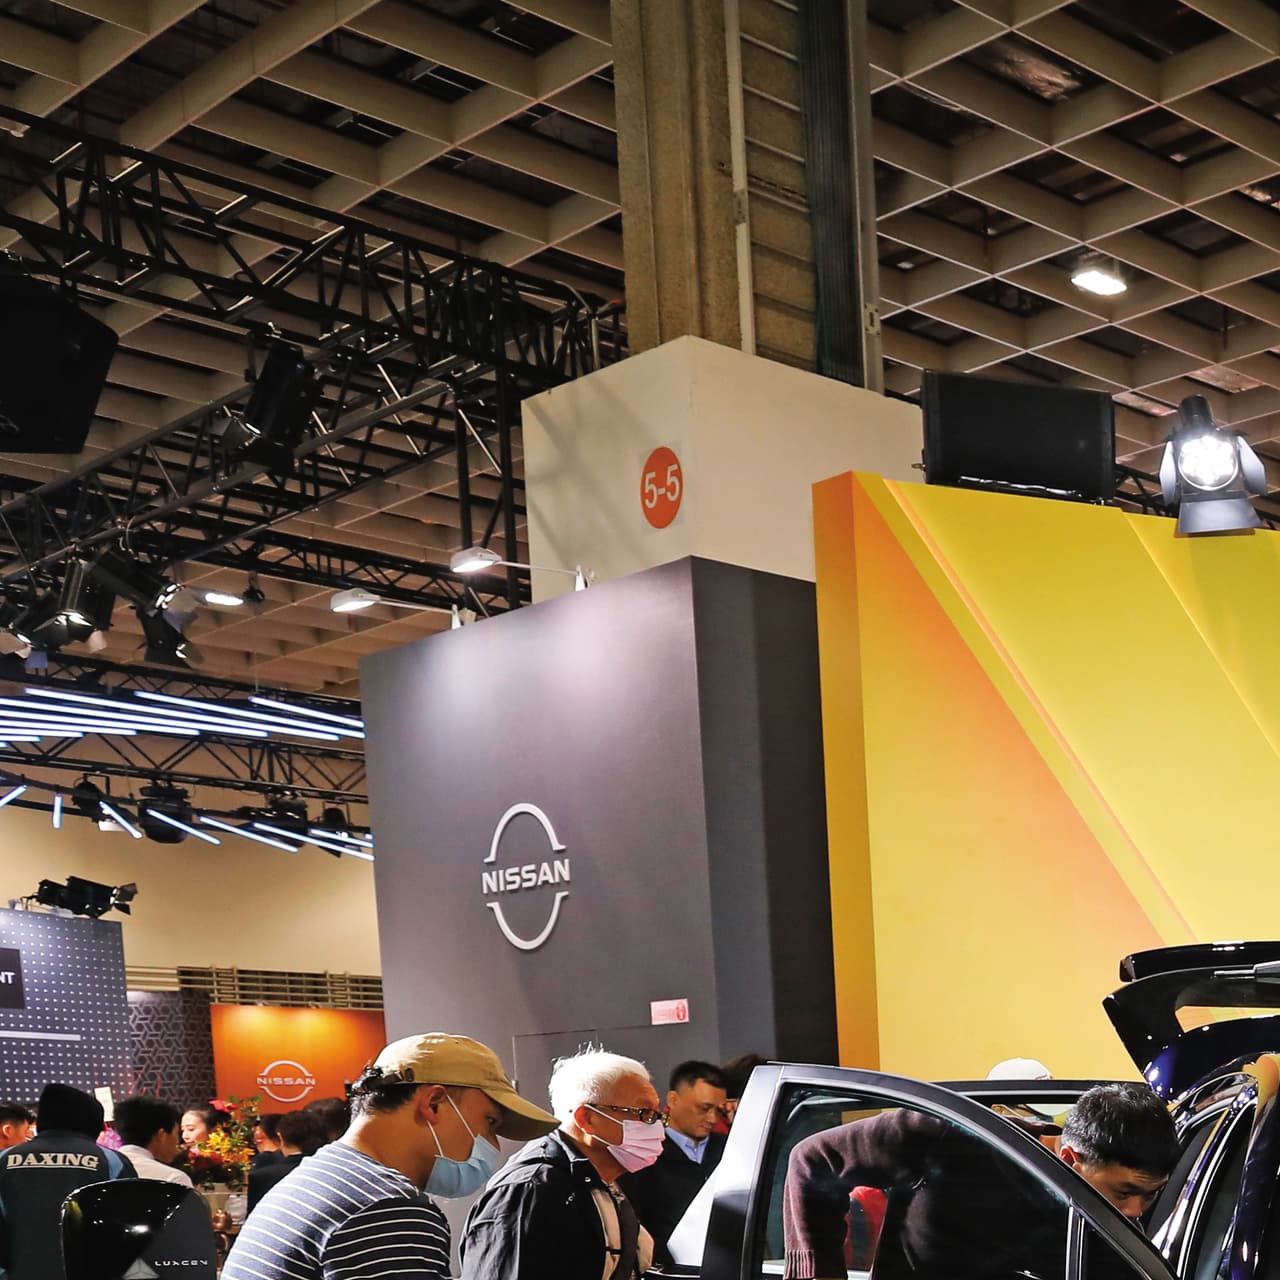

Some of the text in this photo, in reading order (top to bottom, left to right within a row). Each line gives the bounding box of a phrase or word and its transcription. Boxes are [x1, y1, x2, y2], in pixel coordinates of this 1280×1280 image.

[644, 463, 680, 509] 5-5
[481, 858, 571, 894] NISSAN
[256, 1076, 316, 1086] NISSAN
[7, 1153, 100, 1170] DAXING
[154, 1259, 209, 1267] LUXGEN
